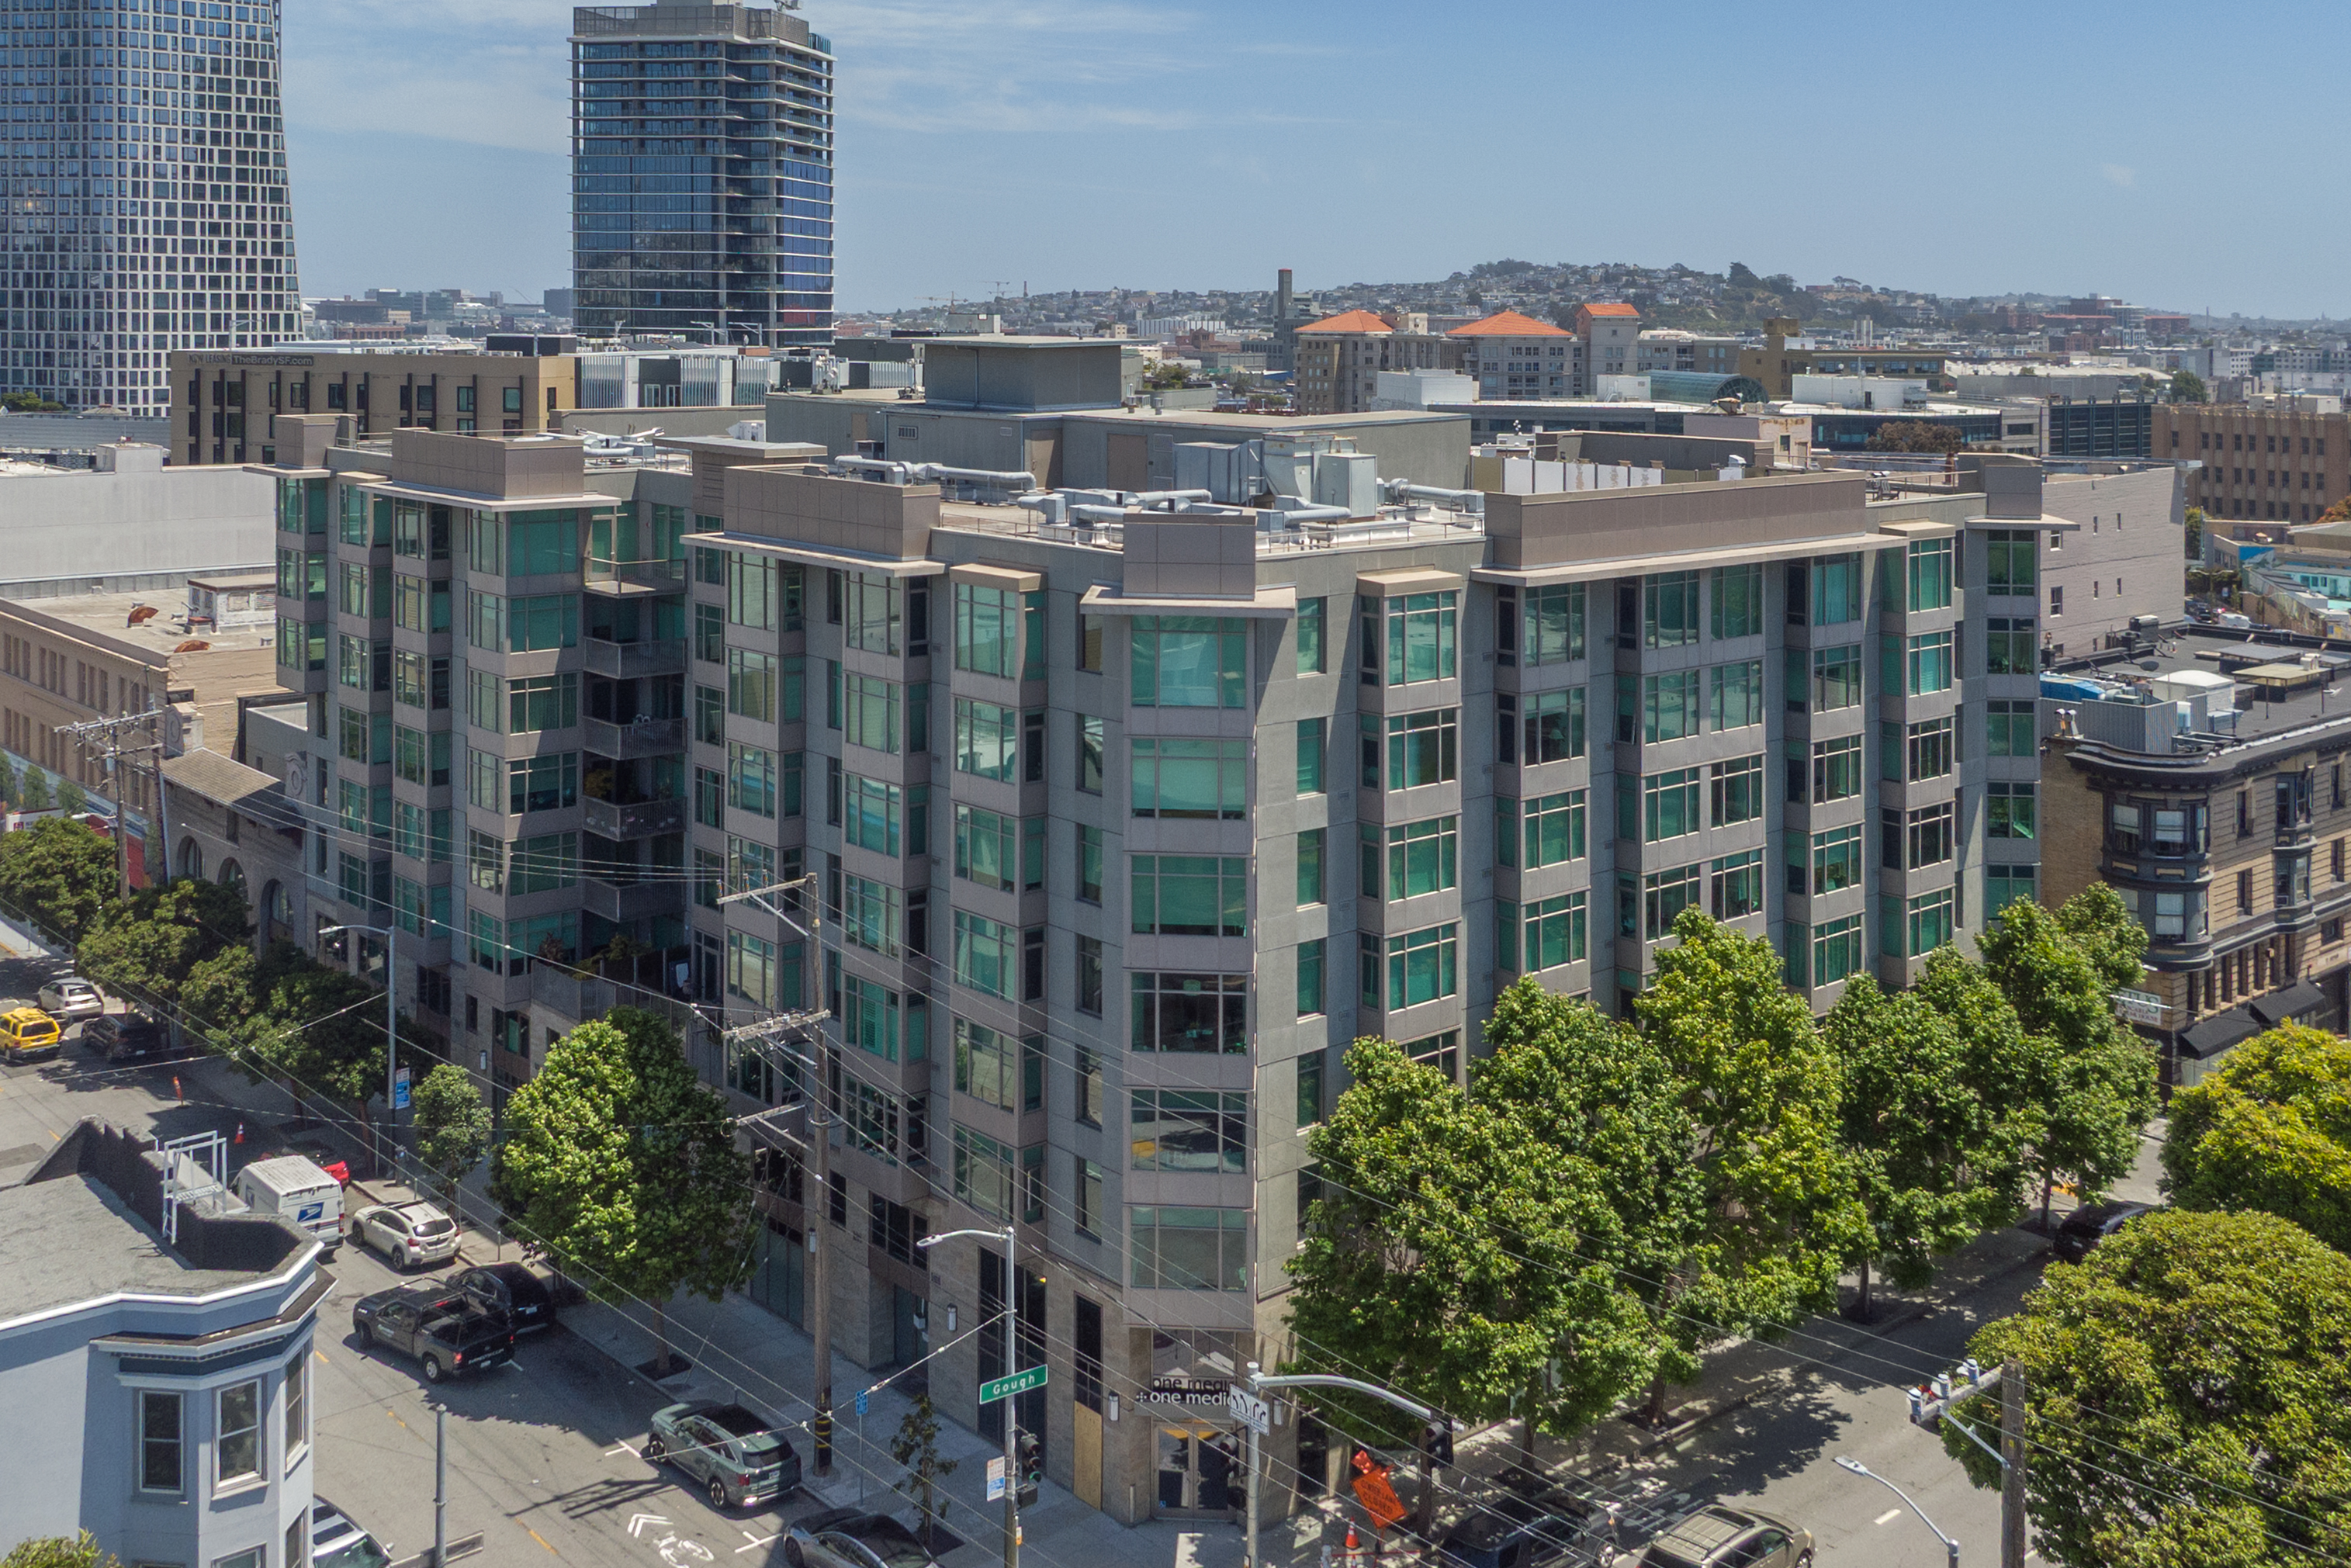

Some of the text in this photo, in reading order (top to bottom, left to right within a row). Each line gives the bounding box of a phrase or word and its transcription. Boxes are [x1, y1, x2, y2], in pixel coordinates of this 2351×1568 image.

[234, 355, 313, 365] TheBradySF.com
[993, 1374, 1035, 1394] Gough
[1150, 1392, 1231, 1406] one medi
